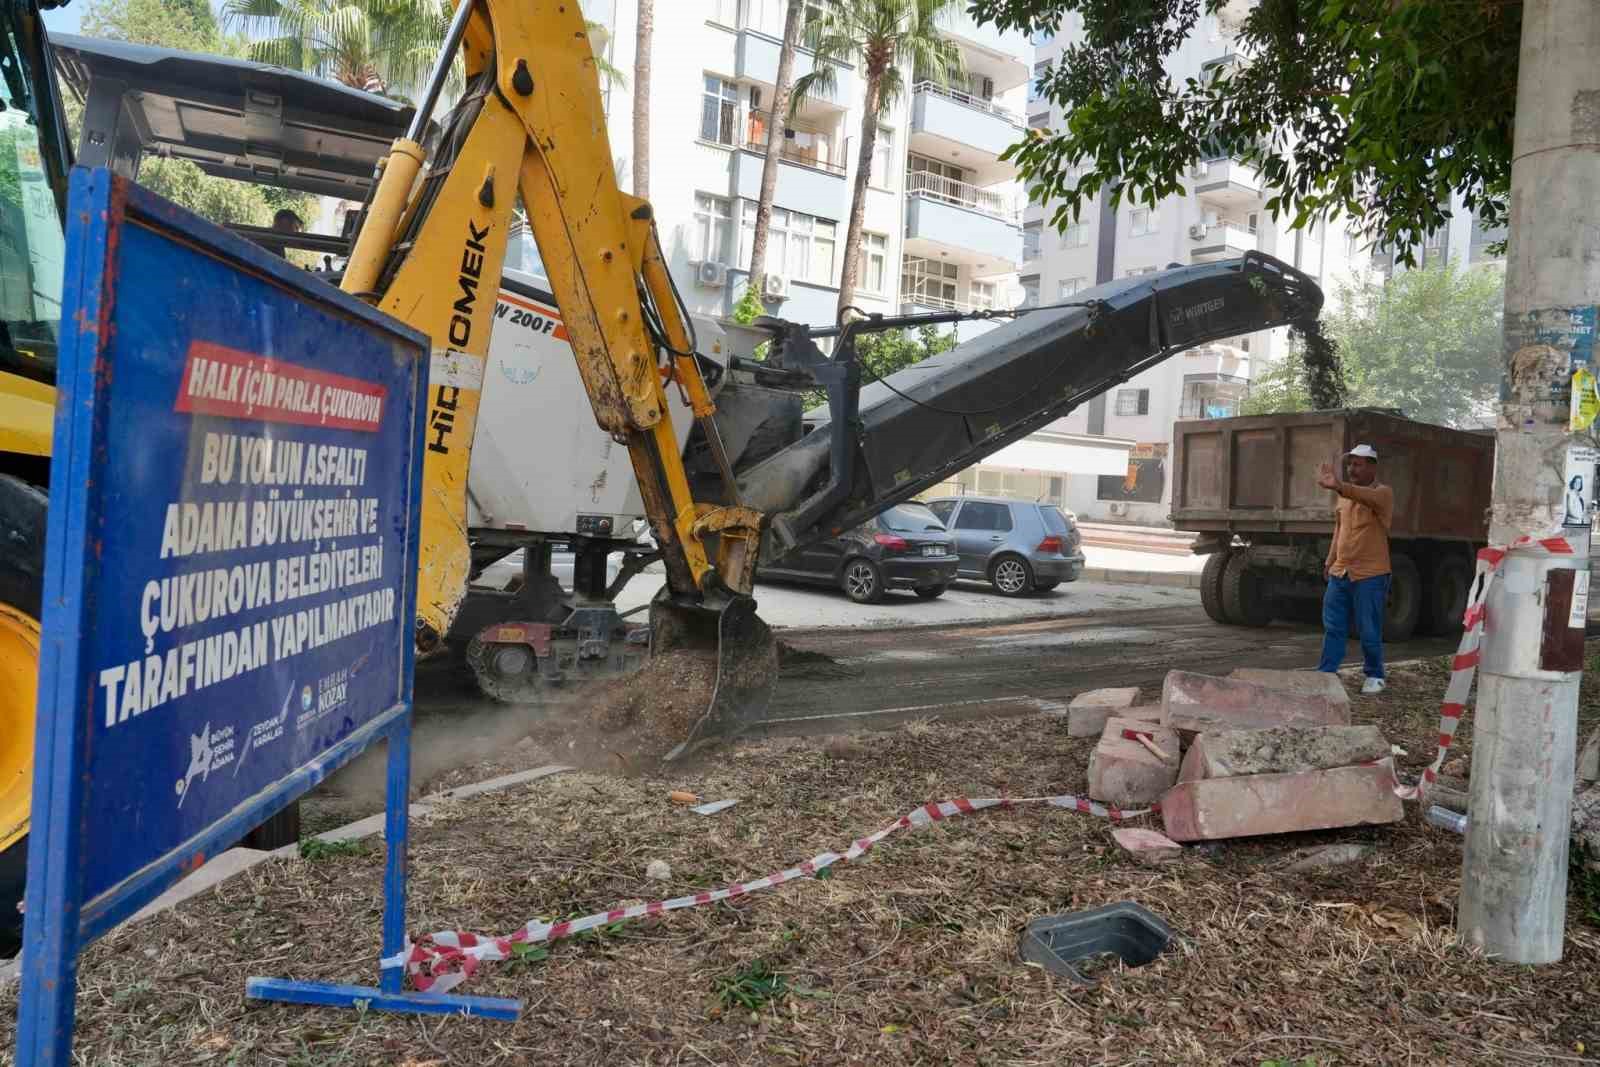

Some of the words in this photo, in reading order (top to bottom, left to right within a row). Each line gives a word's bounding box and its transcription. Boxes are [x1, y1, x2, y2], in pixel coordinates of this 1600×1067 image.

[187, 357, 243, 403] HALK
[241, 360, 275, 416] İÇİN
[273, 377, 321, 415] PARLA
[321, 386, 381, 425] ÇUKUROVA
[200, 432, 237, 485] BU
[239, 436, 304, 487] YOLUN
[303, 442, 367, 487] ASFALTI
[160, 502, 249, 559] ADANA
[249, 489, 360, 551] BÜYÜKŞEHİR
[361, 498, 379, 534] VE
[141, 561, 271, 654] ÇUKUROVA
[275, 536, 383, 603] BELEDİYELERİ
[100, 620, 269, 728] TARAFINDAN
[271, 587, 395, 661] YAPILMAKTADIR
